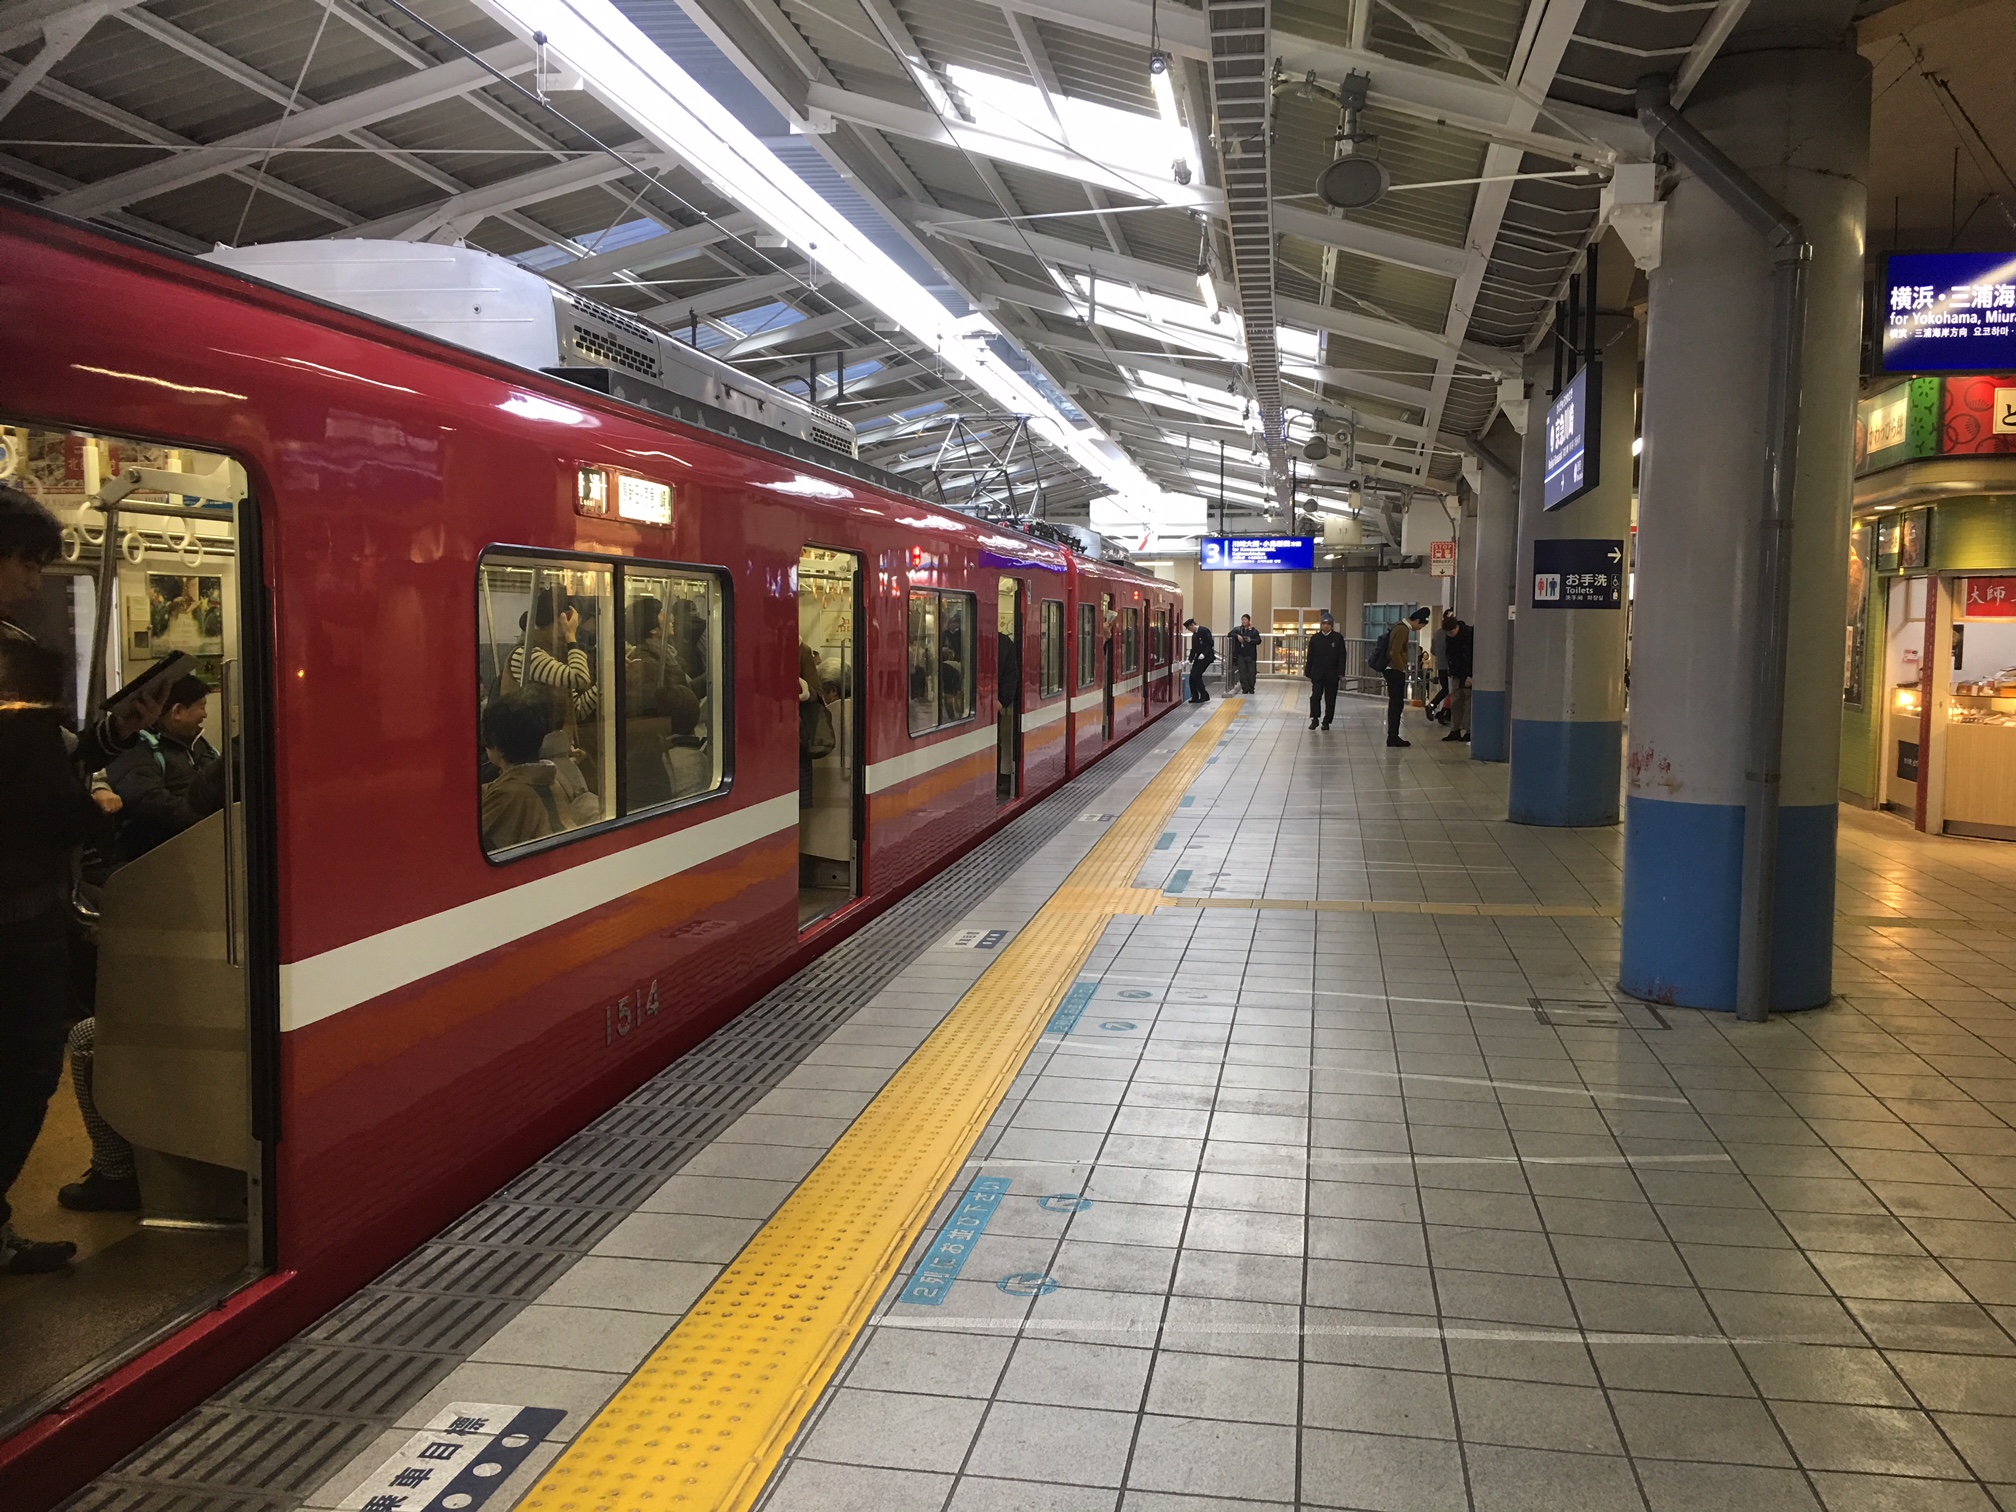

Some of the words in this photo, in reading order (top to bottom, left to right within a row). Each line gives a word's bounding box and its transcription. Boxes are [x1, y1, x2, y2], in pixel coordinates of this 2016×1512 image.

[1889, 312, 1909, 325] for
[1913, 311, 1981, 325] Yokohama,
[1206, 543, 1221, 564] 3
[1566, 573, 1608, 587] お手洗
[1566, 586, 1594, 594] Toilets
[1967, 585, 2016, 607] 大師
[606, 979, 660, 1046] 1514
